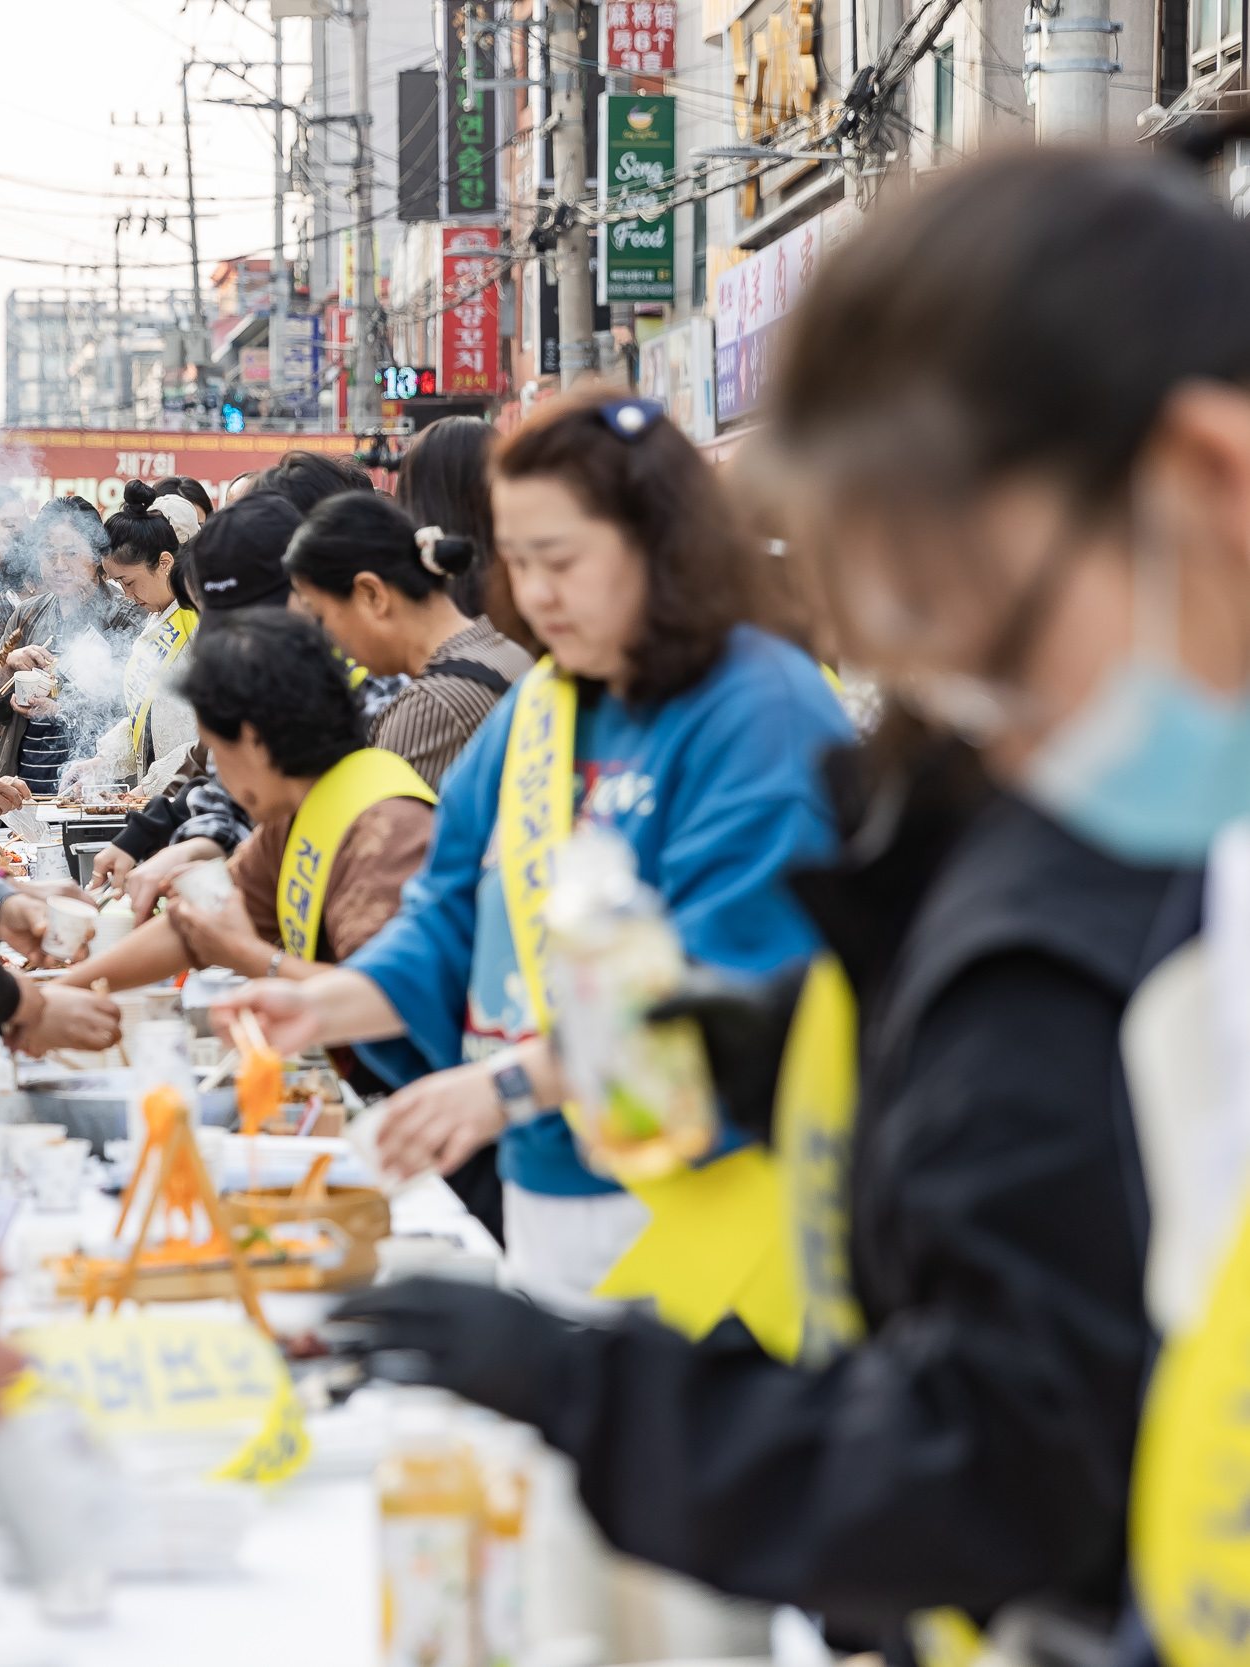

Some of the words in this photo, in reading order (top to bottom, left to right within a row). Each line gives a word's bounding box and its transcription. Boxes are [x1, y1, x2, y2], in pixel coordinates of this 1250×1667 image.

[615, 151, 664, 188] Song
[613, 220, 666, 249] Food
[115, 451, 176, 477] 제7회
